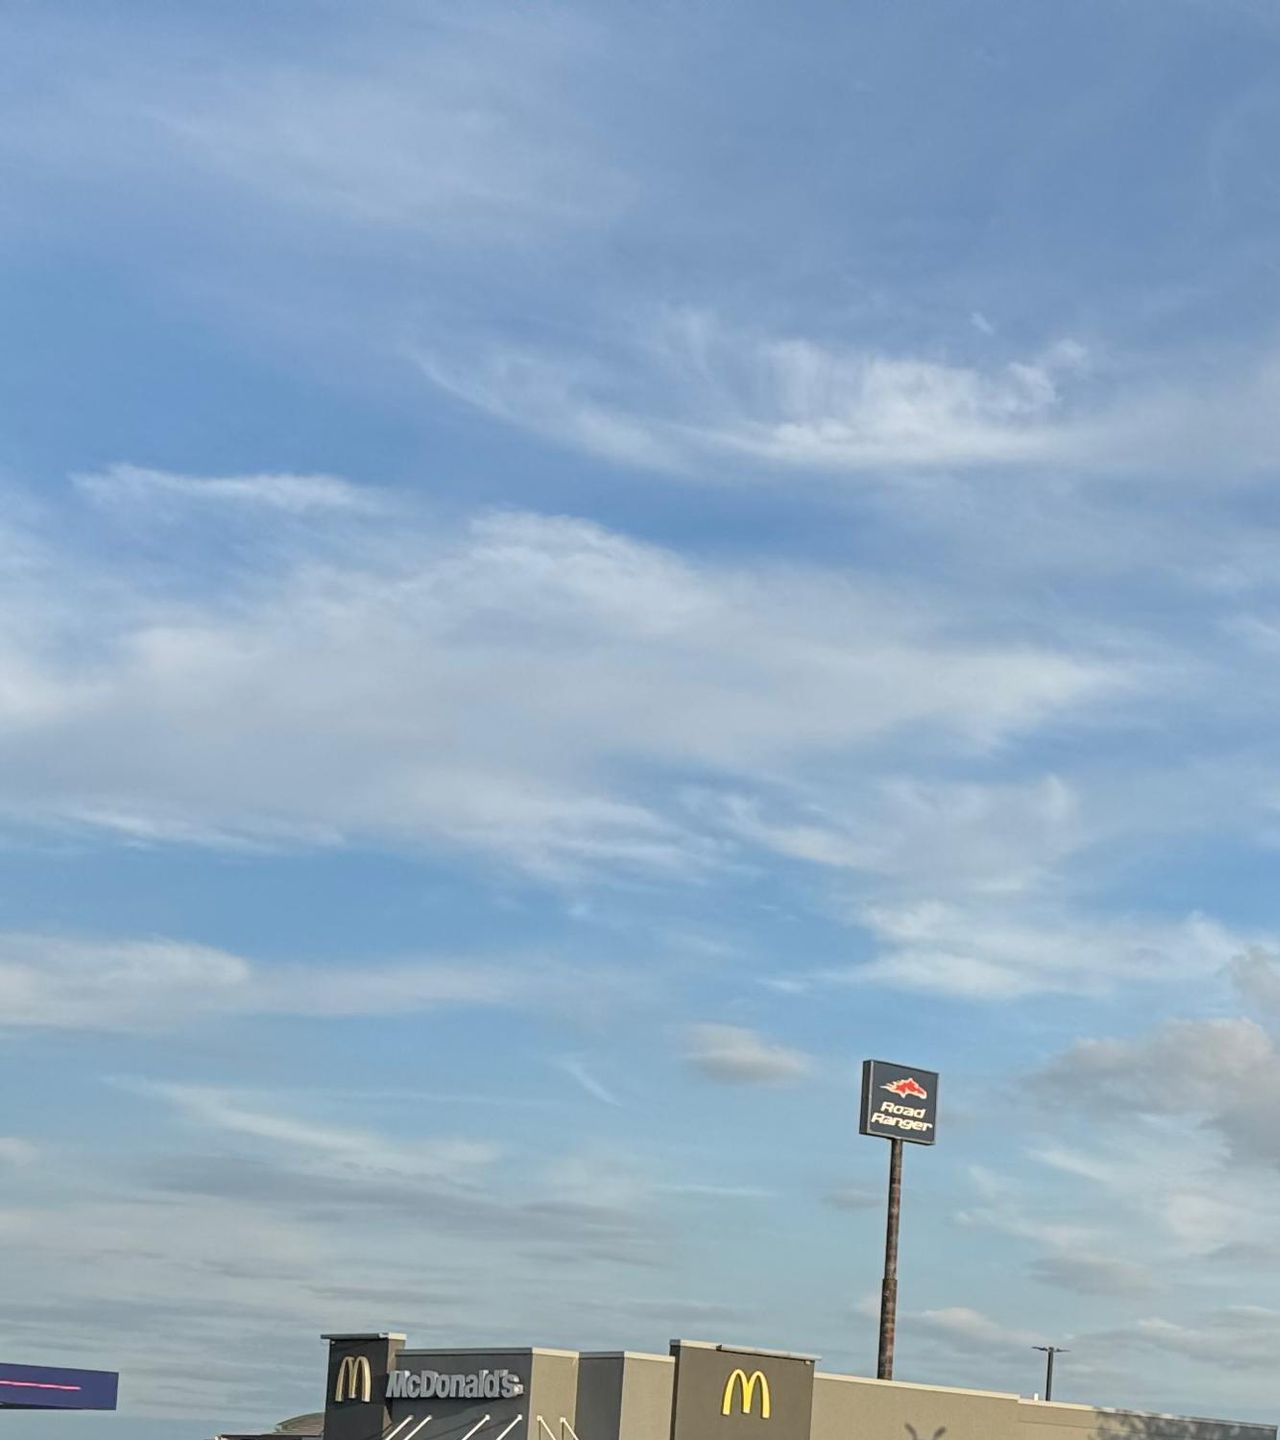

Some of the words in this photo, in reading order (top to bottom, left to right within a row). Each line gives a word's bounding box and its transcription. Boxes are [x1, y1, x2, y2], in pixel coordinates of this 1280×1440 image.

[880, 1101, 927, 1119] Road
[871, 1112, 933, 1131] Ranger
[385, 1369, 524, 1398] McDonald's
